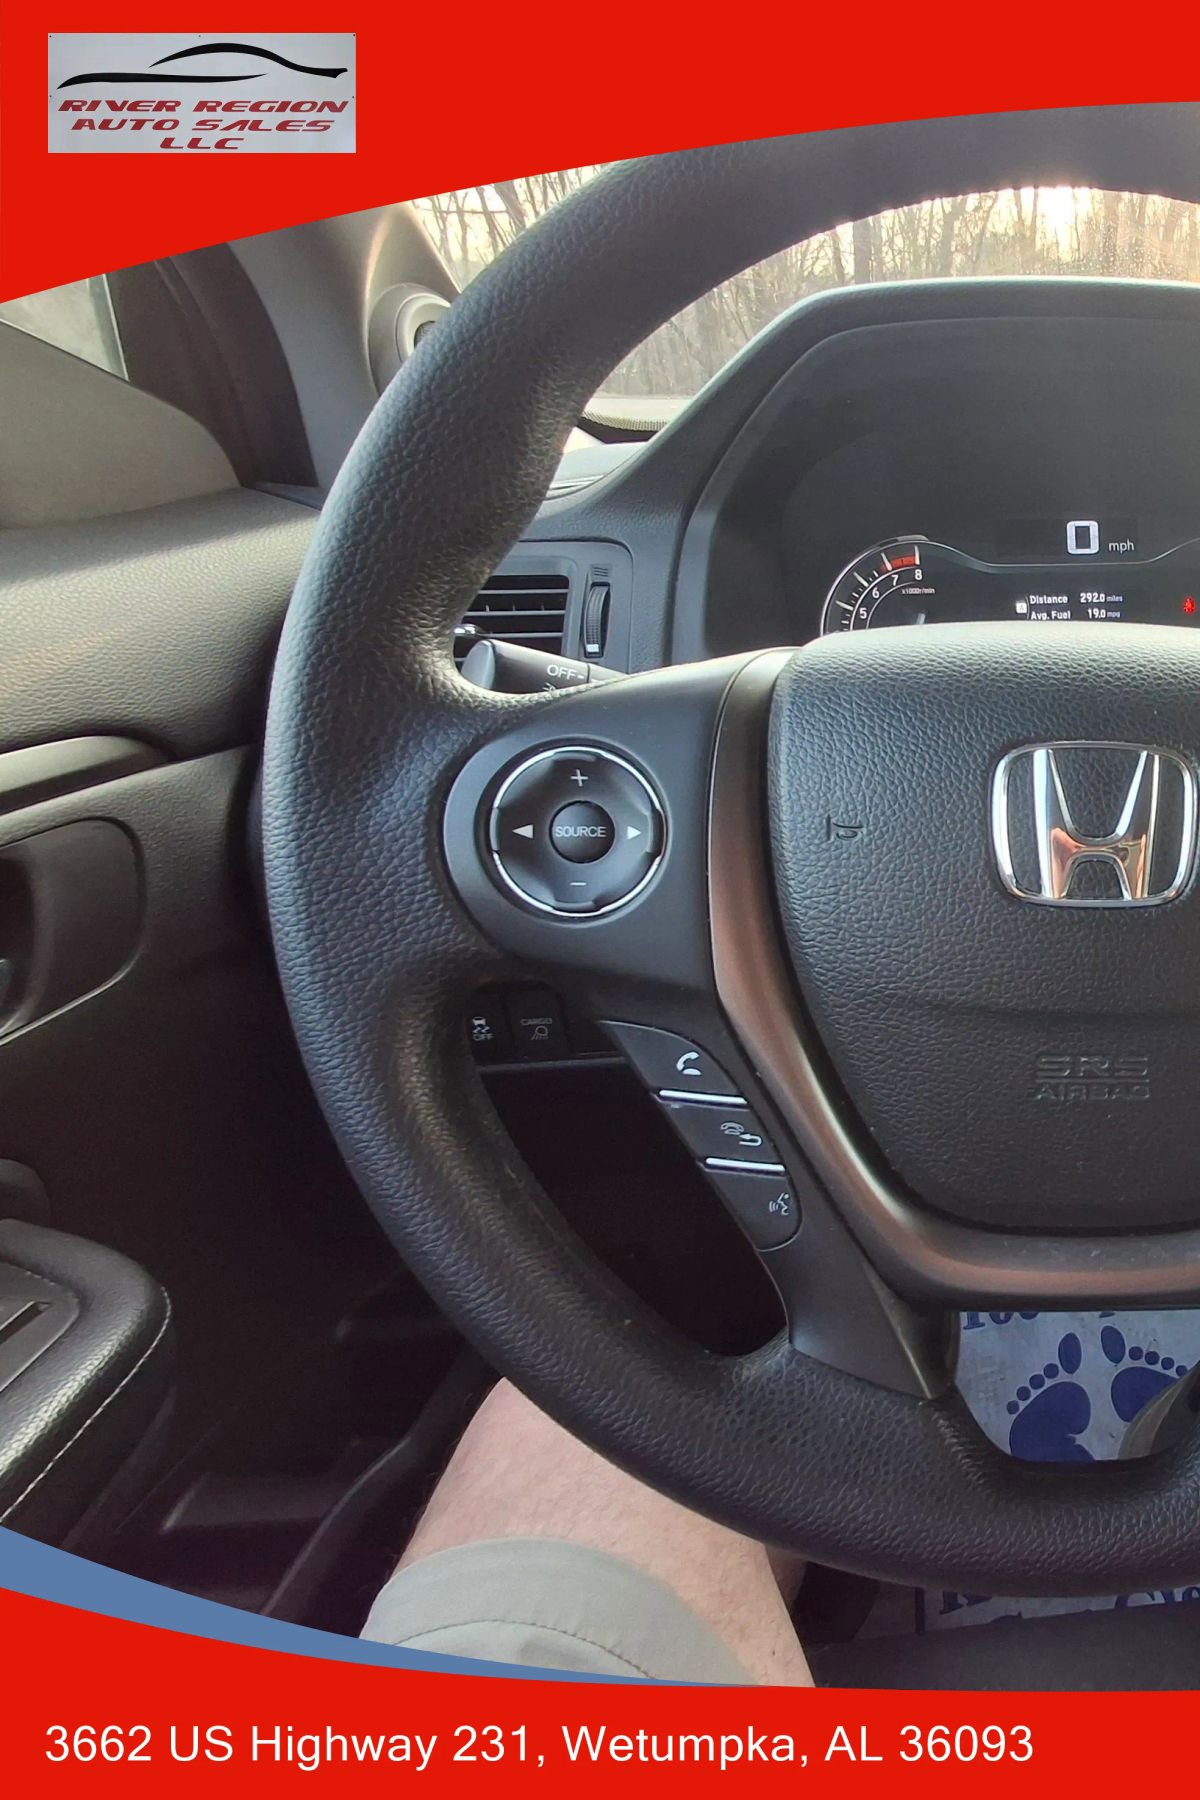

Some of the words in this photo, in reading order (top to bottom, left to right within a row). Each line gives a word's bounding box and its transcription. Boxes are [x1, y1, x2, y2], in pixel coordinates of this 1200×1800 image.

[1108, 538, 1135, 554] mph
[891, 574, 899, 586] 7
[914, 568, 923, 580] 8
[871, 587, 880, 599] 6
[1029, 594, 1068, 605] Distance
[1080, 592, 1106, 603] 292.0
[859, 607, 867, 619] 5
[1031, 610, 1050, 620] Avg.
[1051, 610, 1071, 620] Fuel
[1088, 607, 1106, 619] 19.0
[547, 664, 577, 680] OFF
[555, 825, 606, 838] SOURCE
[472, 1033, 494, 1041] OFF
[1037, 1056, 1149, 1078] SRS
